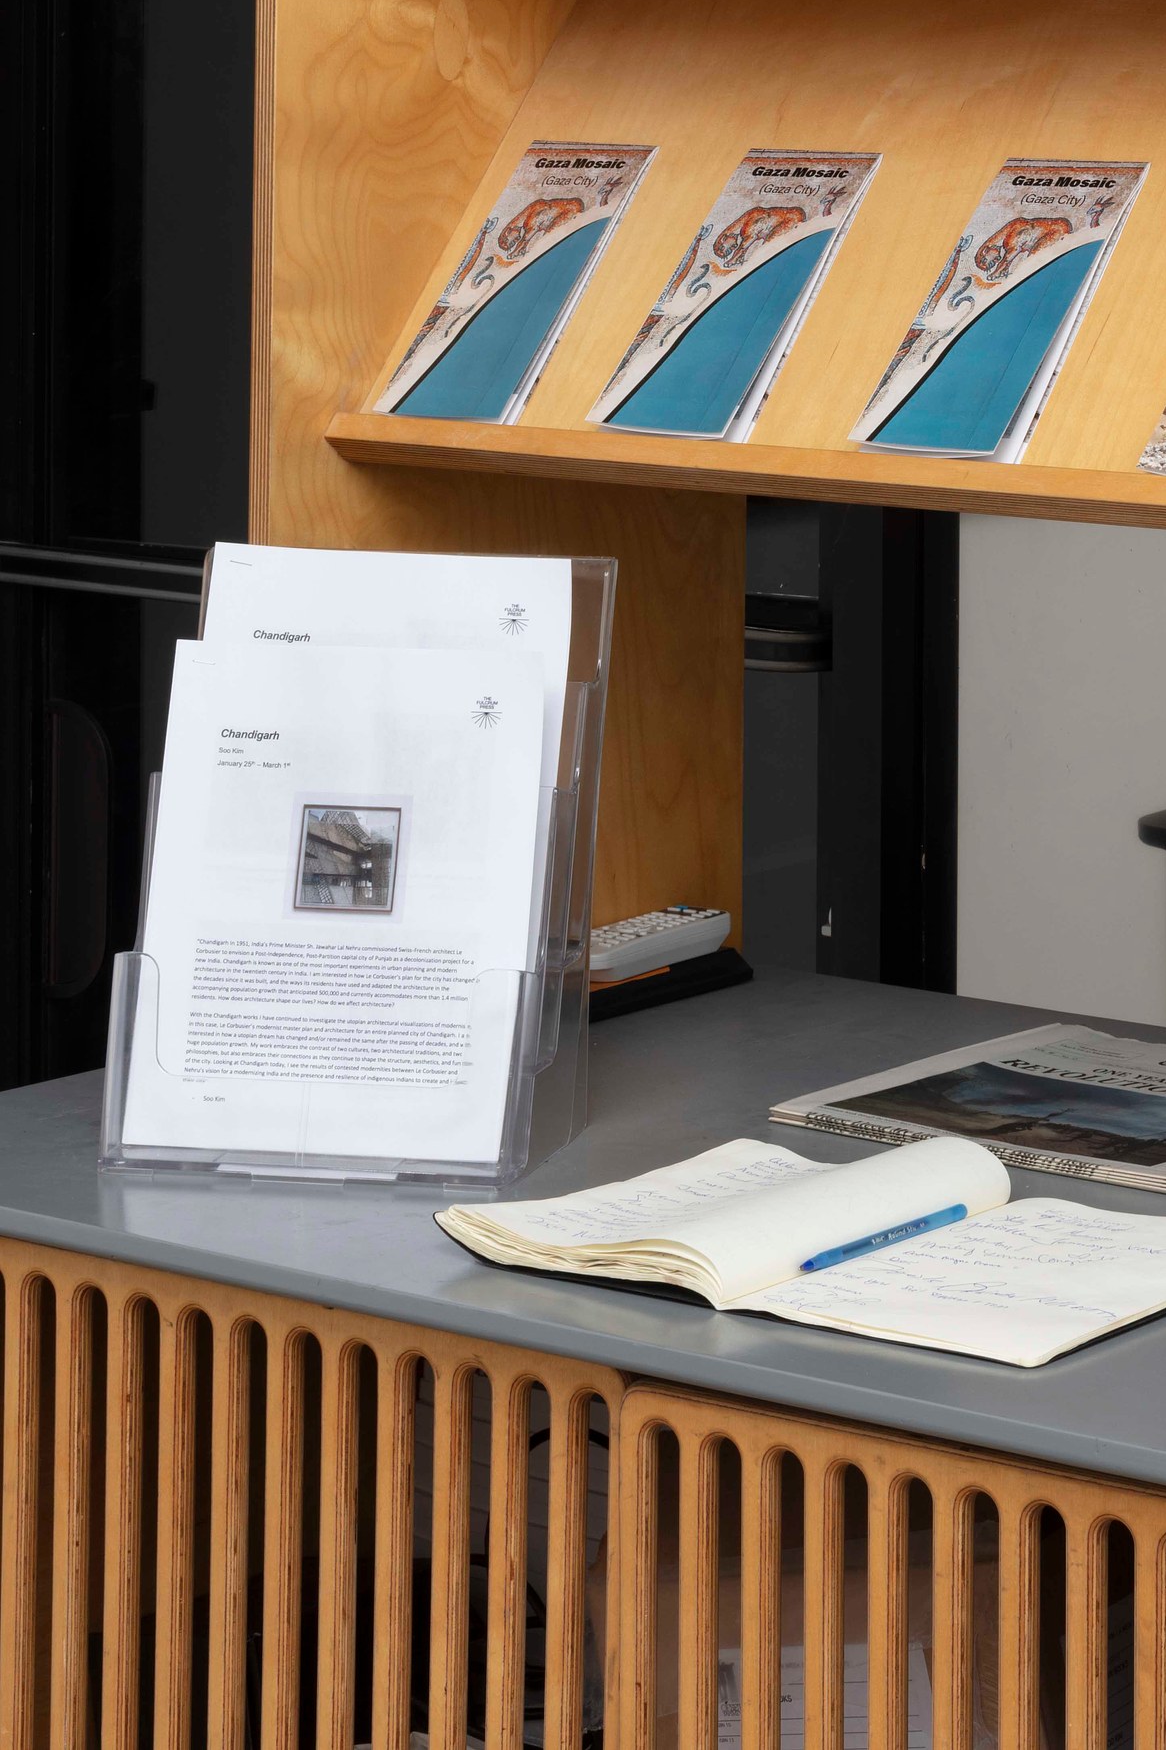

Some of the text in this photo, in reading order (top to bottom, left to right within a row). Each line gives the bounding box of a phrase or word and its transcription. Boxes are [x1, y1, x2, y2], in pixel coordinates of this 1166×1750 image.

[535, 158, 626, 169] Gaza Mosaic
[752, 166, 849, 178] Gaza Mosaic
[541, 176, 598, 187] (Gaza City)
[1012, 176, 1116, 188] Gaza Mosaic
[759, 184, 821, 196] (Gaza City)
[1021, 193, 1086, 207] (Gaza City)
[253, 630, 311, 644] Chandigarh
[221, 729, 280, 742] Chandigarh
